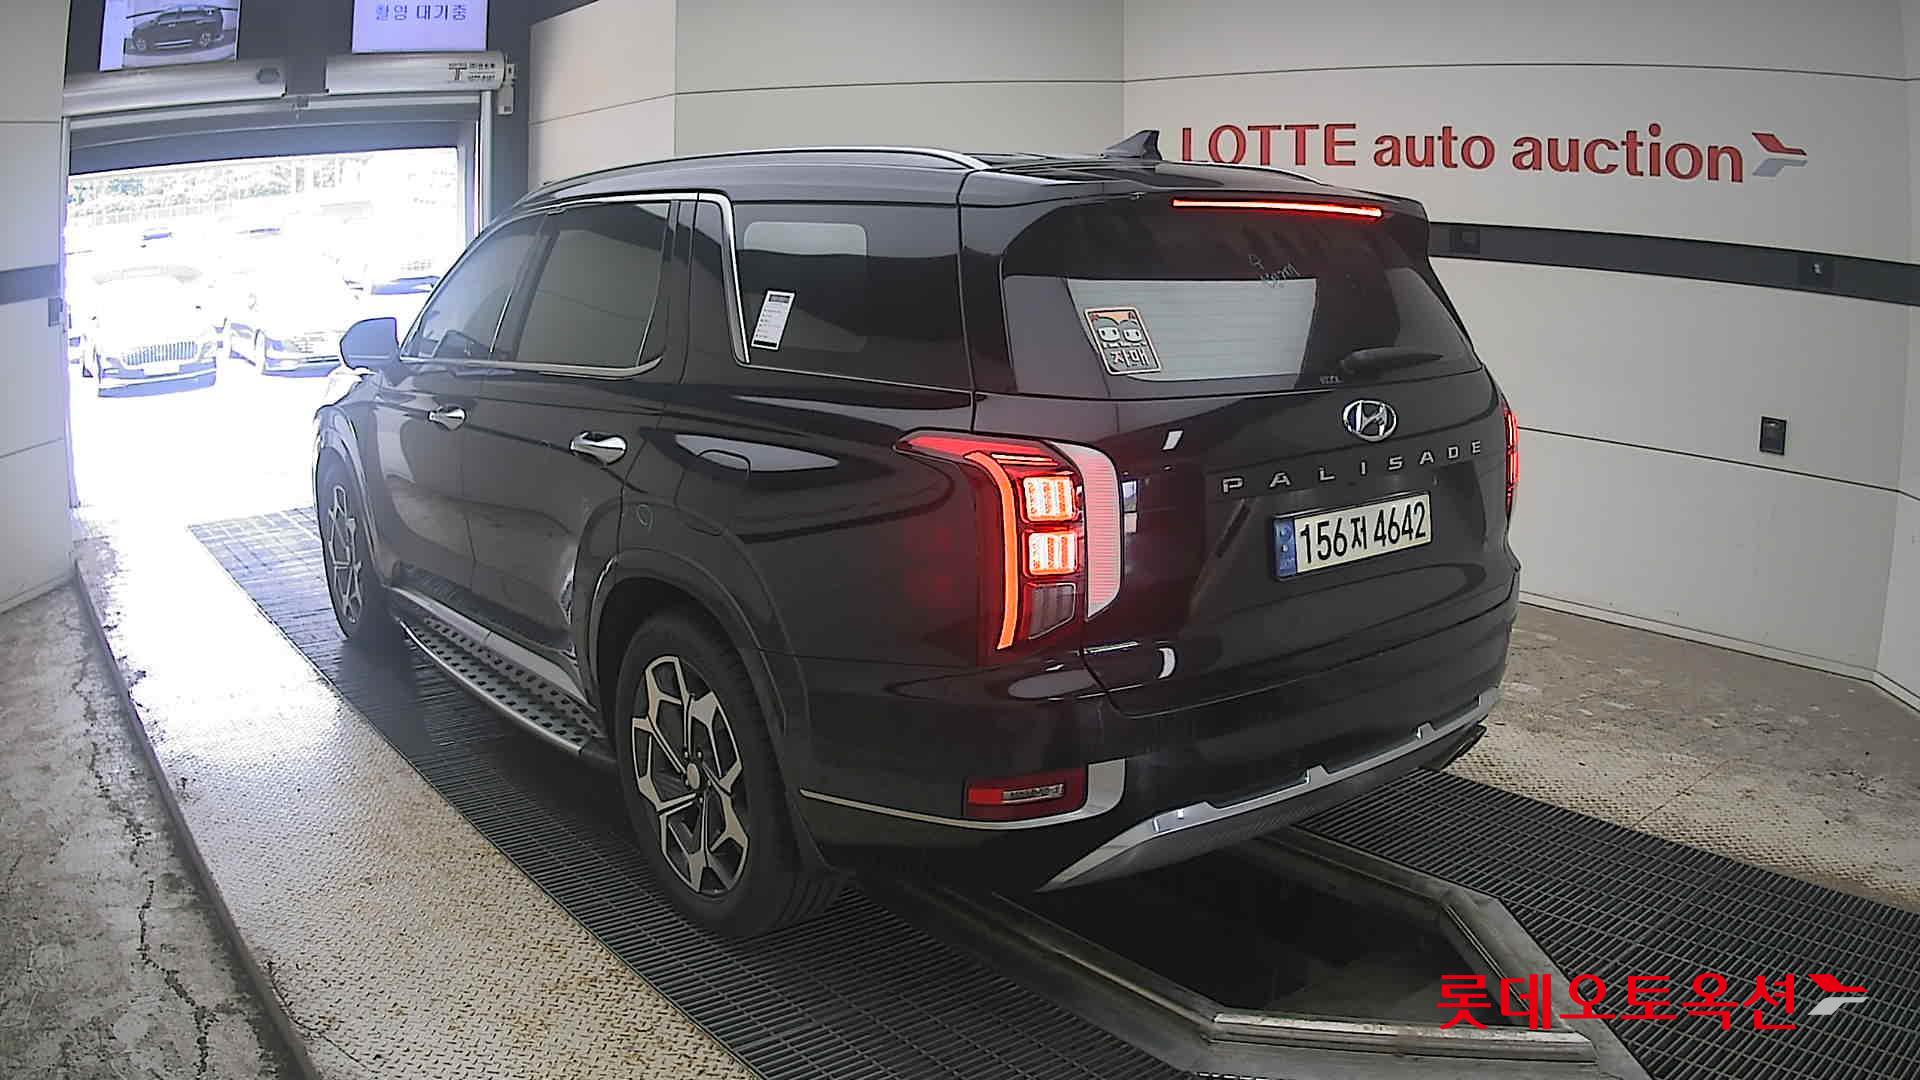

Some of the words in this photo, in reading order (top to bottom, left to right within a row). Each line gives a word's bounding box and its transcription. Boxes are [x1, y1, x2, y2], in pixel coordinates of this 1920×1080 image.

[416, 4, 467, 21] 대기중
[1182, 123, 1357, 167] LOTTE
[1372, 127, 1496, 170] auto
[1512, 122, 1744, 182] auction
[1222, 440, 1482, 493] PALISADE
[1299, 515, 1368, 564] 156저
[1373, 501, 1427, 547] 4642
